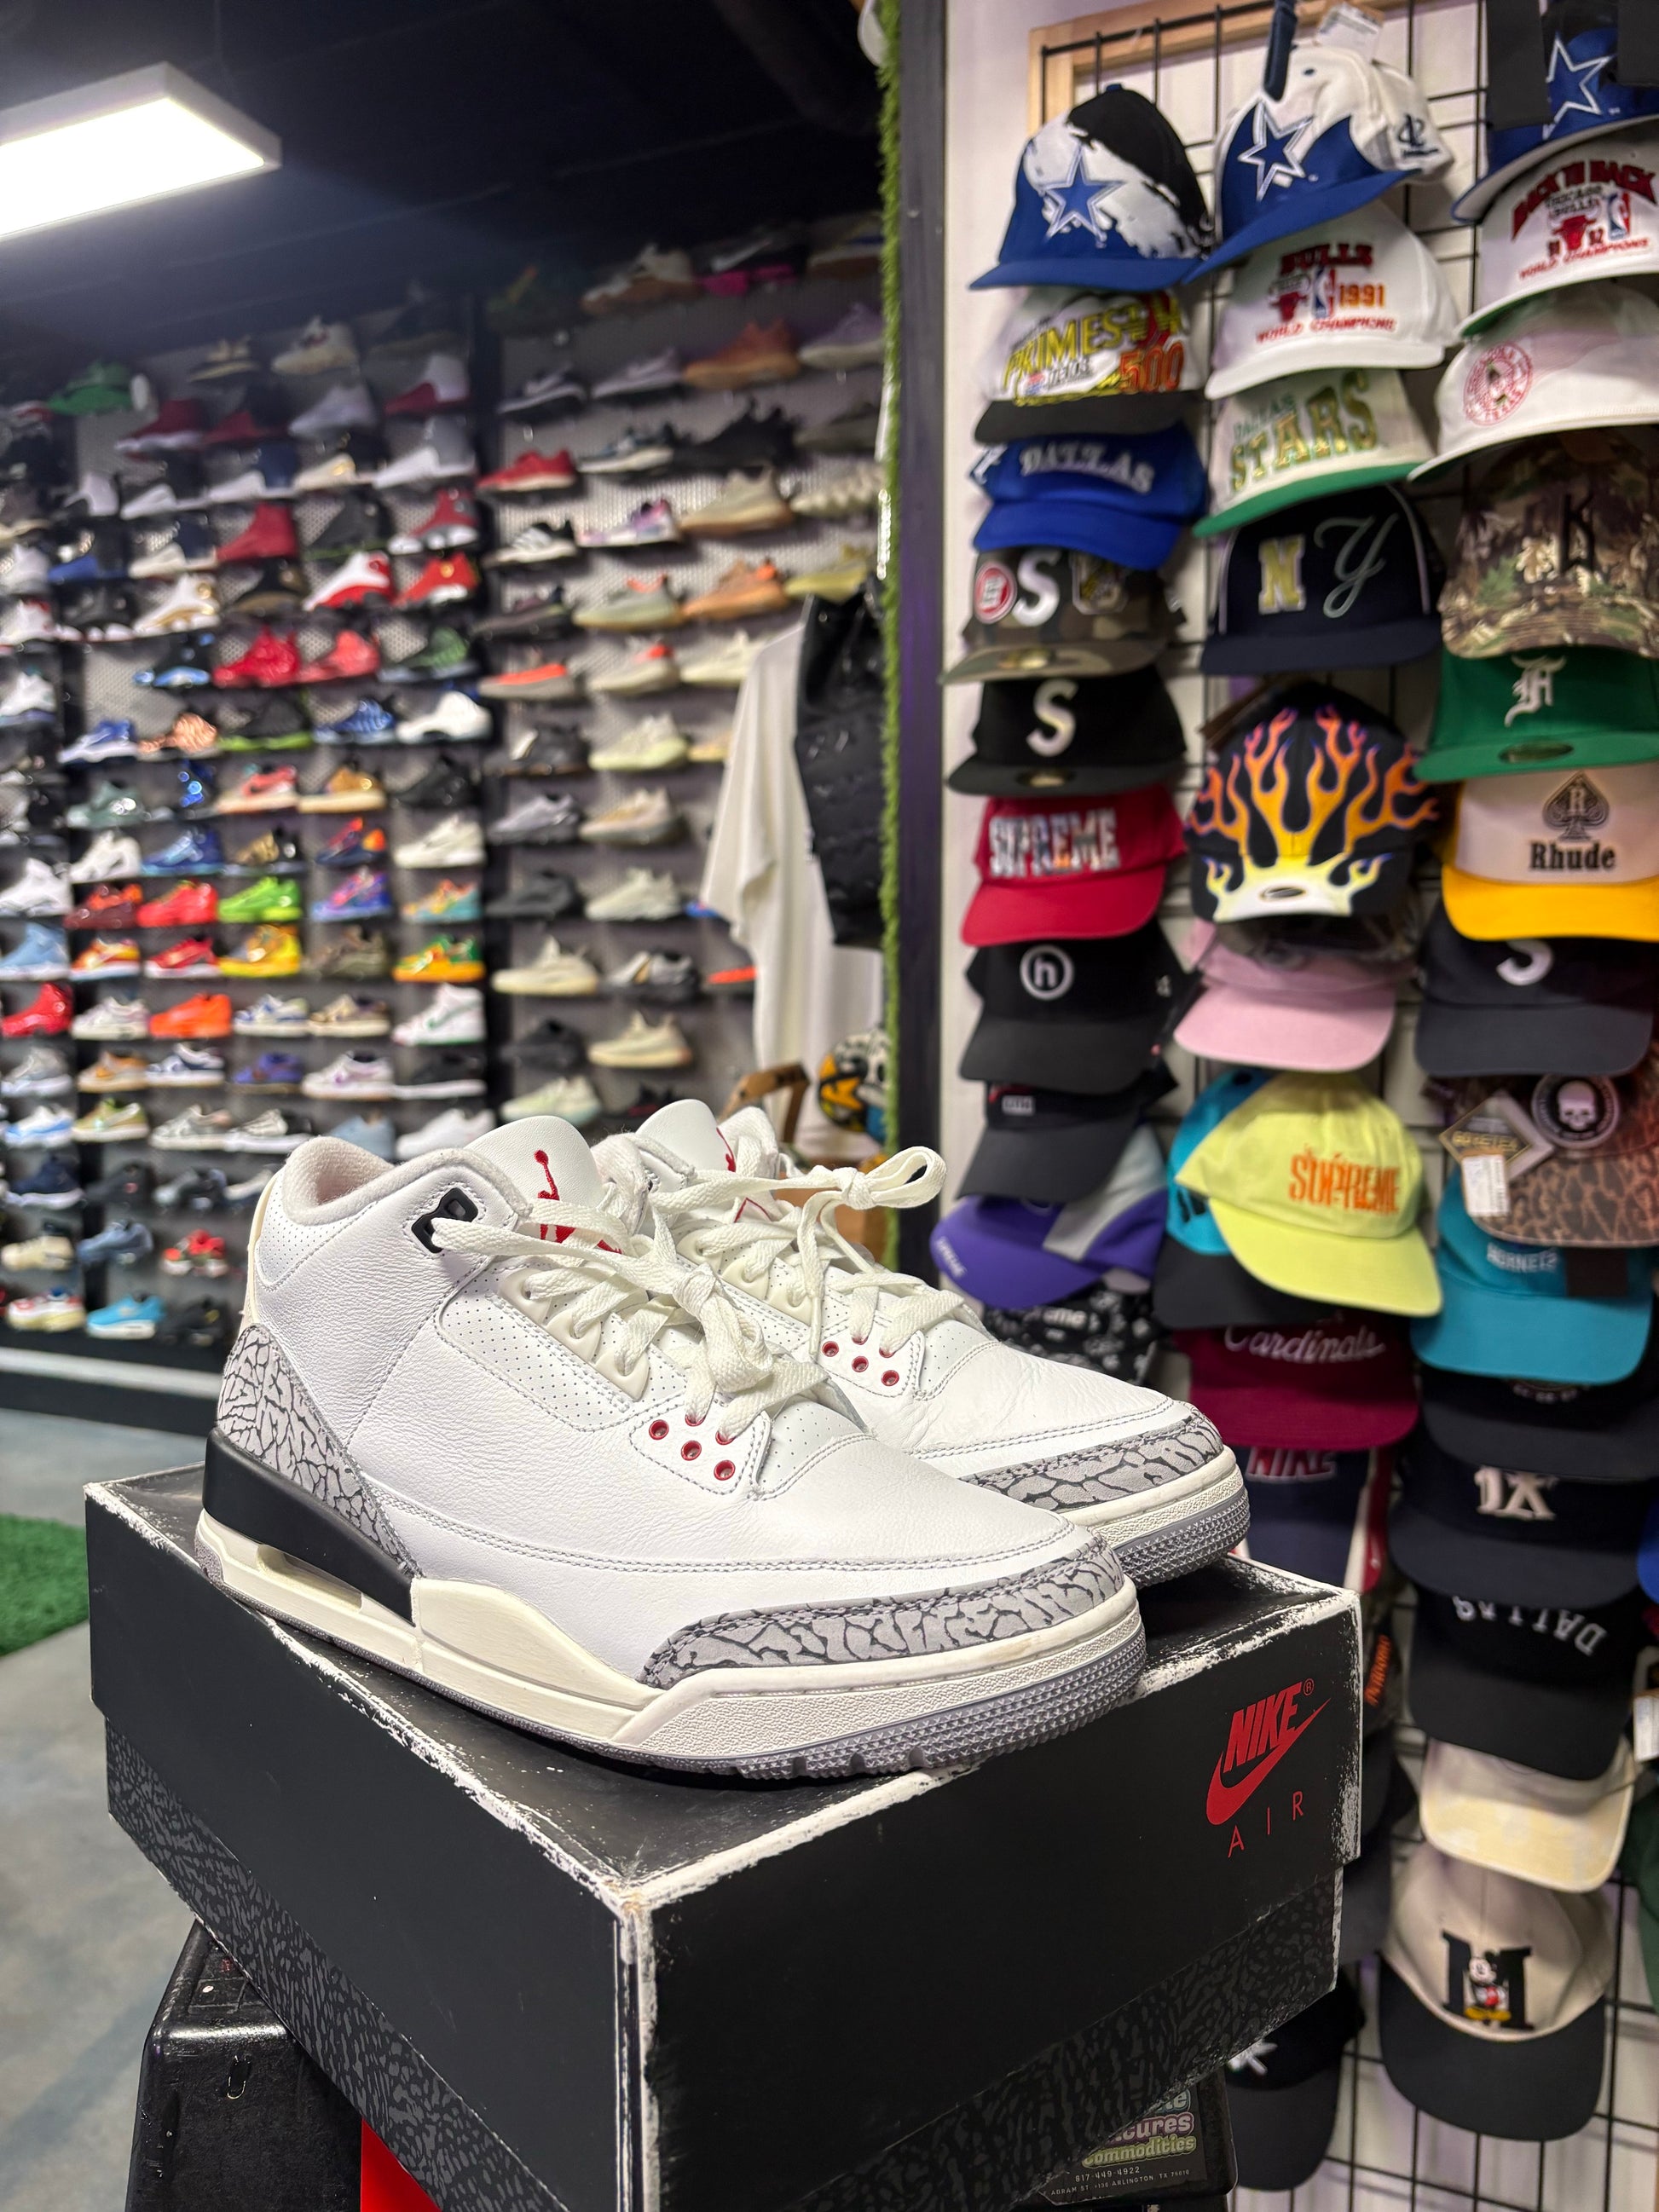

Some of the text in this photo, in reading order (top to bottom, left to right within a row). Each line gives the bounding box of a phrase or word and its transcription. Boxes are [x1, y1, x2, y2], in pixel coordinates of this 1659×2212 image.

[1339, 283, 1385, 308] 1991
[1119, 341, 1185, 394] 500
[1231, 369, 1378, 492] STARS
[1012, 548, 1060, 627] S
[1258, 534, 1307, 615] N
[1026, 679, 1078, 757] S
[988, 807, 1121, 878] SUPREME
[1529, 840, 1616, 870] Rhude
[1223, 1681, 1303, 1774] NIKE
[1227, 1790, 1304, 1858] AIR
[1075, 2166, 1141, 2183] 817-449-4922
[1112, 2174, 1153, 2187] ARLINGTON
